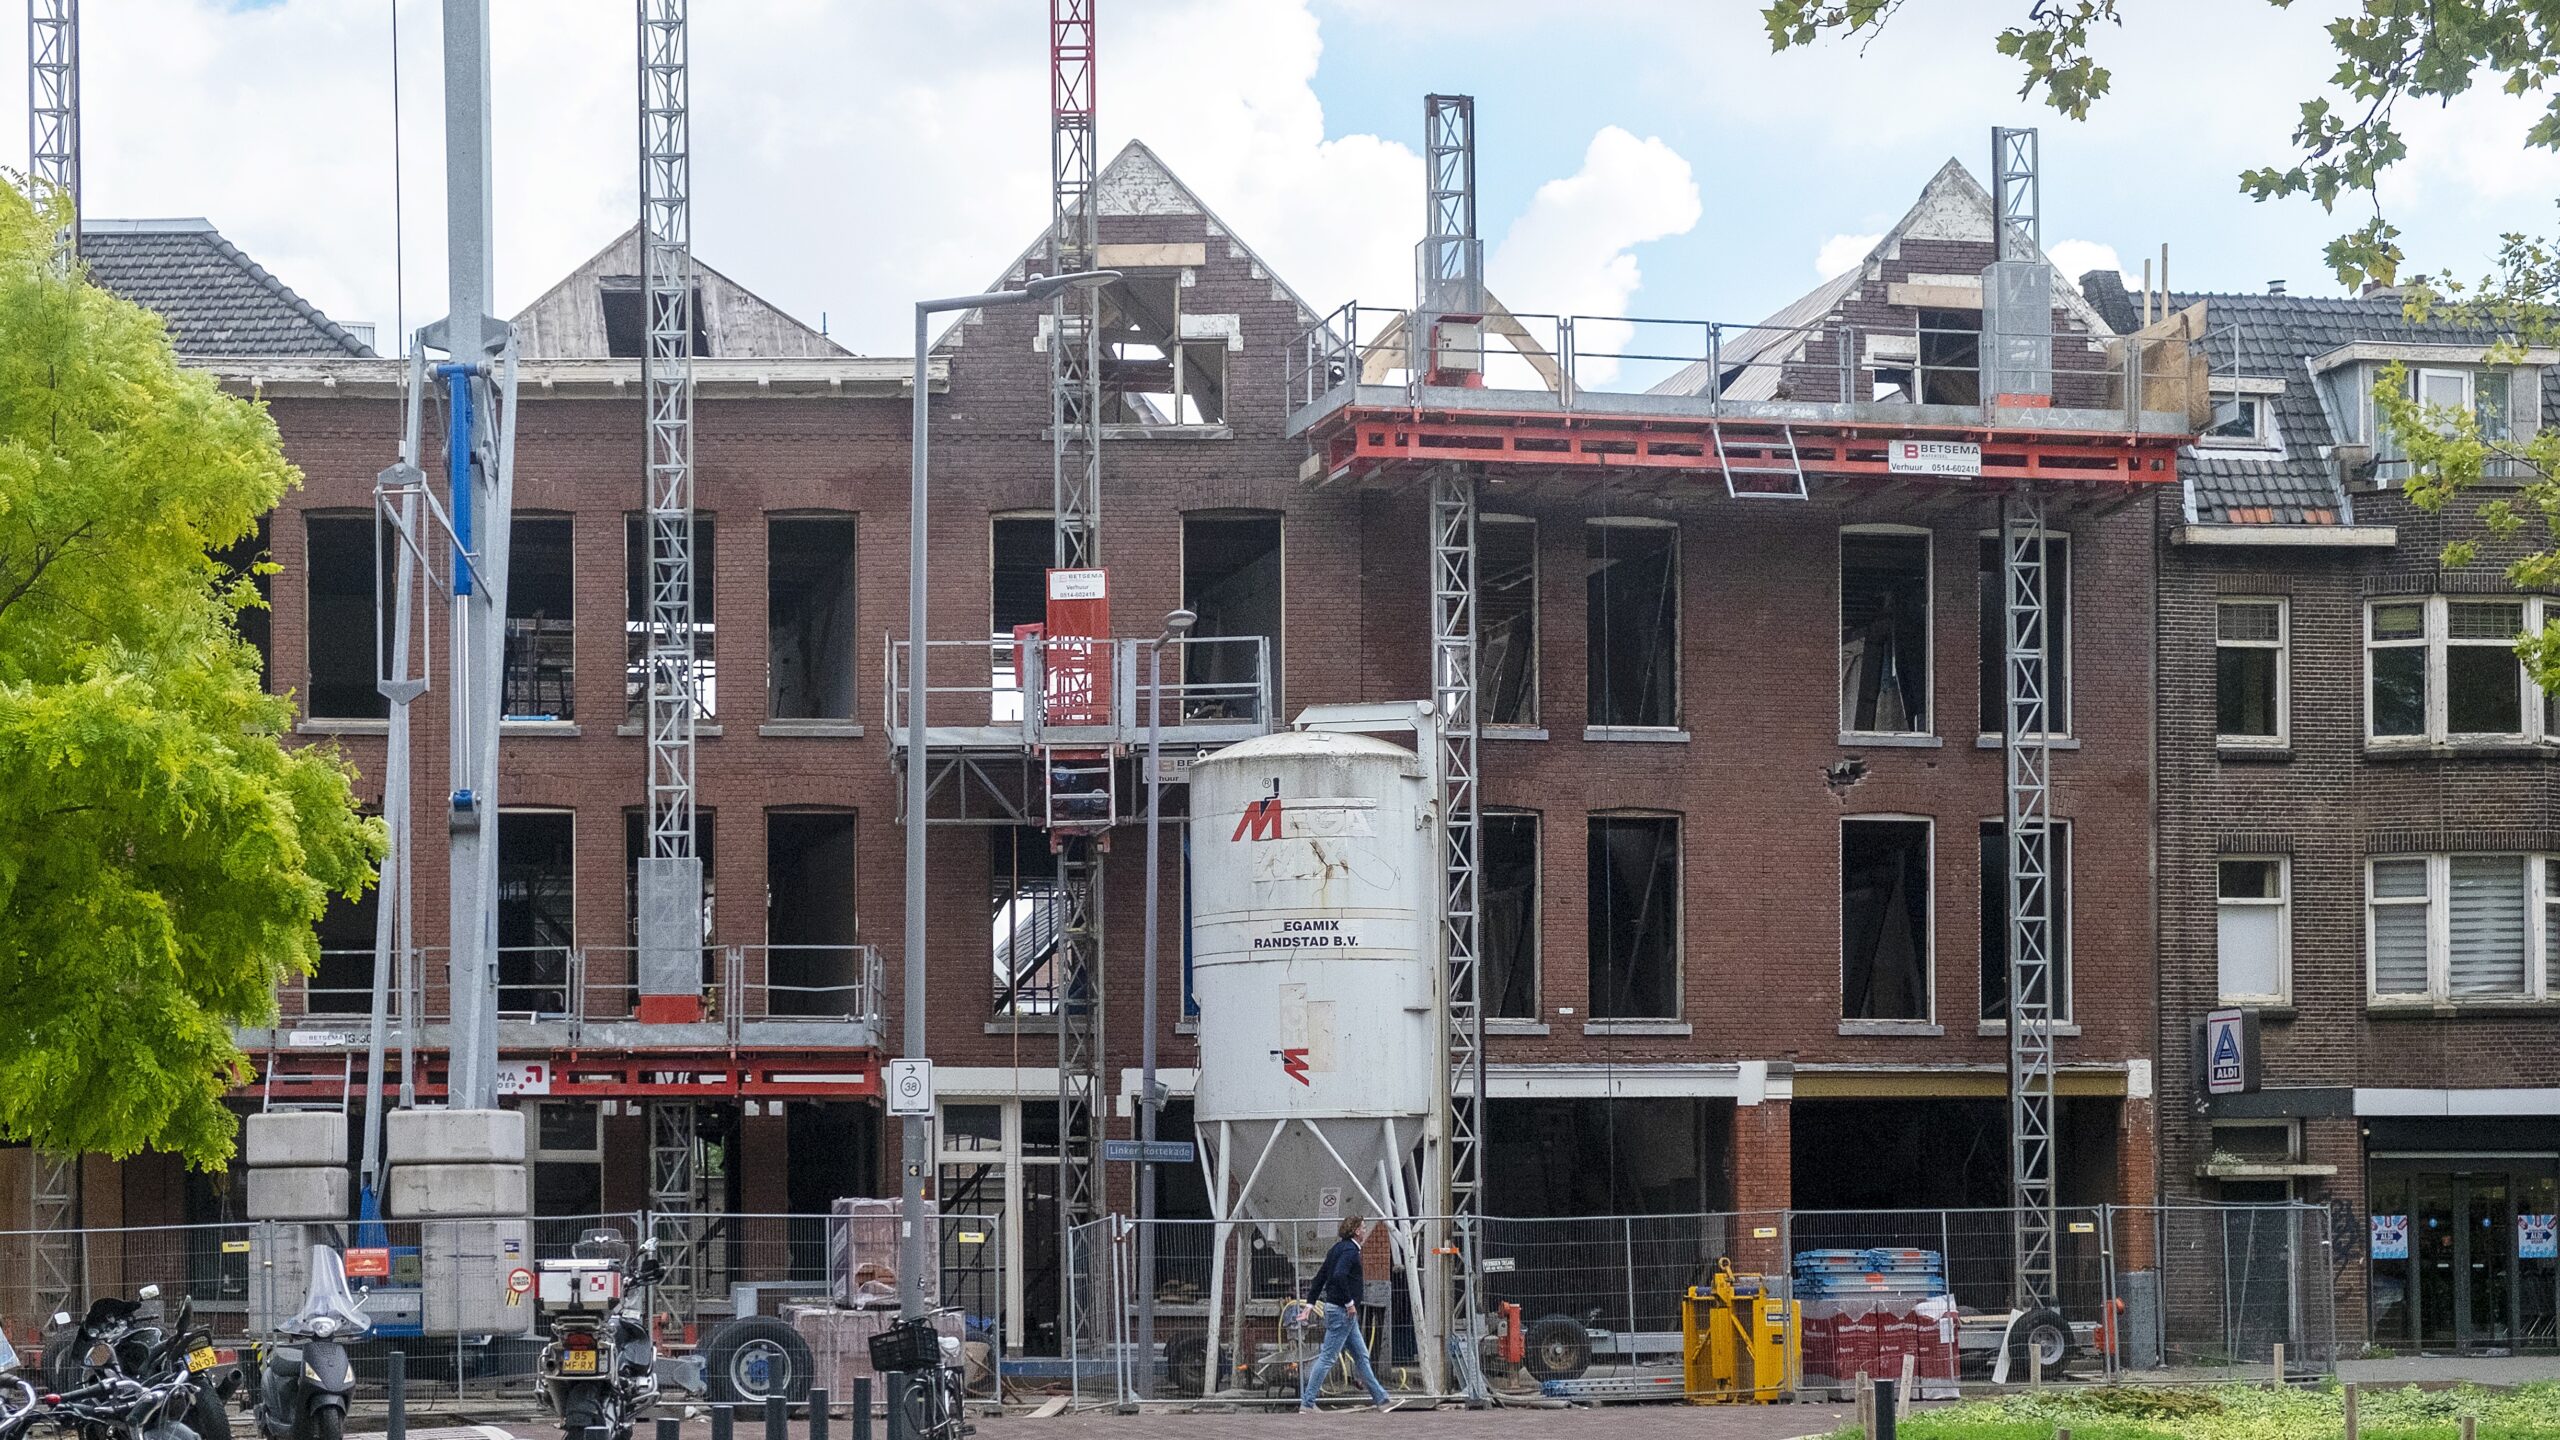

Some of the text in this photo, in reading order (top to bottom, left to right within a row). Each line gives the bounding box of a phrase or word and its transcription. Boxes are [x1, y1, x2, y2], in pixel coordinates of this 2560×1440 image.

[1920, 444, 1980, 455] BETSEMA
[1891, 463, 1979, 474] Verhuur 0514-602418
[1283, 920, 1340, 932] EGAMIX
[1254, 935, 1359, 948] RANDSTAD B.V.
[2216, 1067, 2238, 1079] ALDI
[904, 1082, 917, 1092] 38
[1110, 1146, 1190, 1156] Linker Rottekade
[574, 1351, 588, 1361] 85
